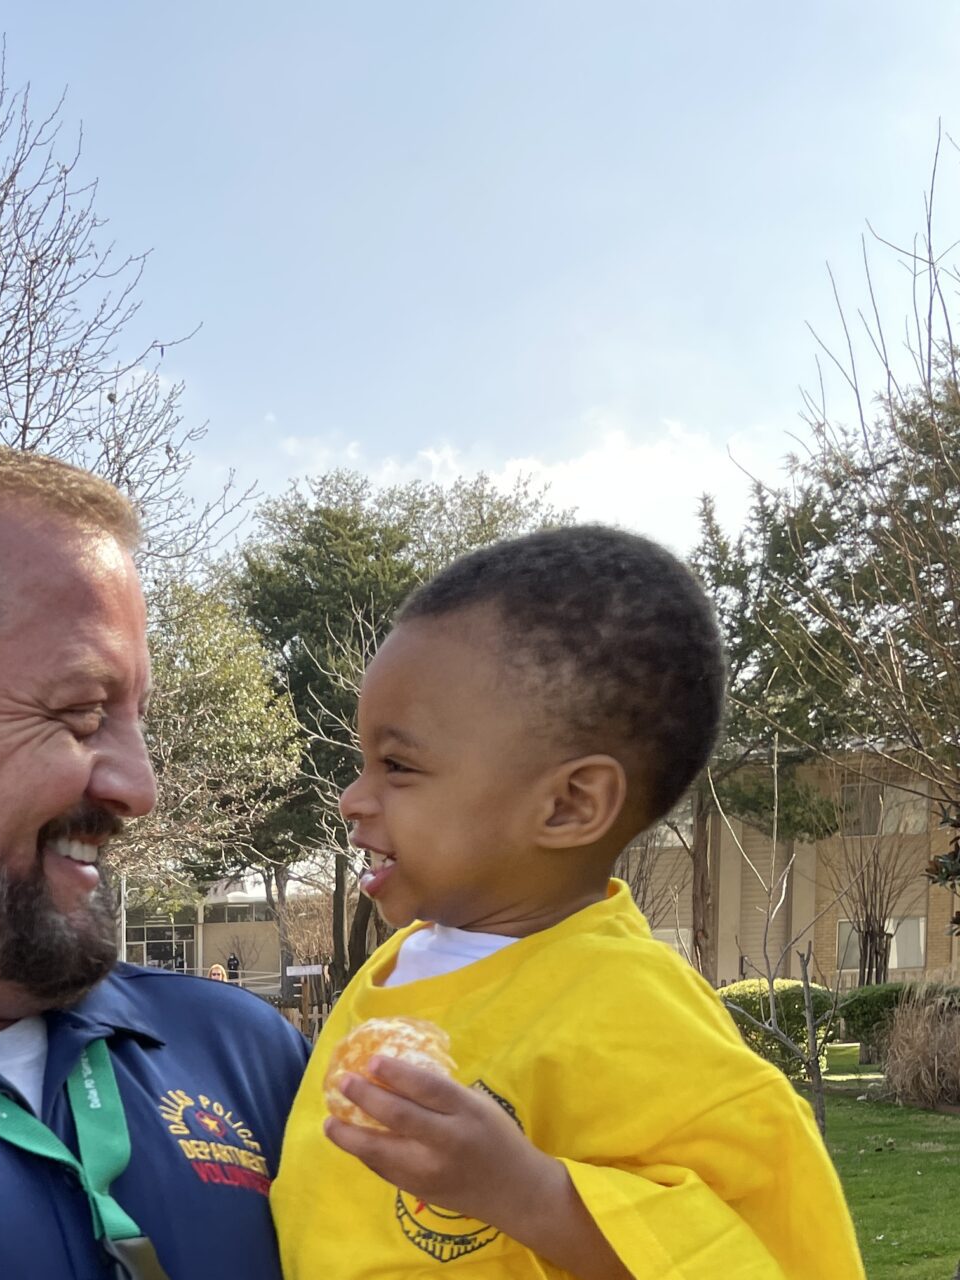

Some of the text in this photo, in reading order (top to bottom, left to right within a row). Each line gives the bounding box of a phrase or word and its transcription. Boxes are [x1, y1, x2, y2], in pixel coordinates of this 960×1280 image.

[158, 1089, 262, 1152] DALLAS POLICE
[178, 1138, 270, 1178] DEPARTMENT
